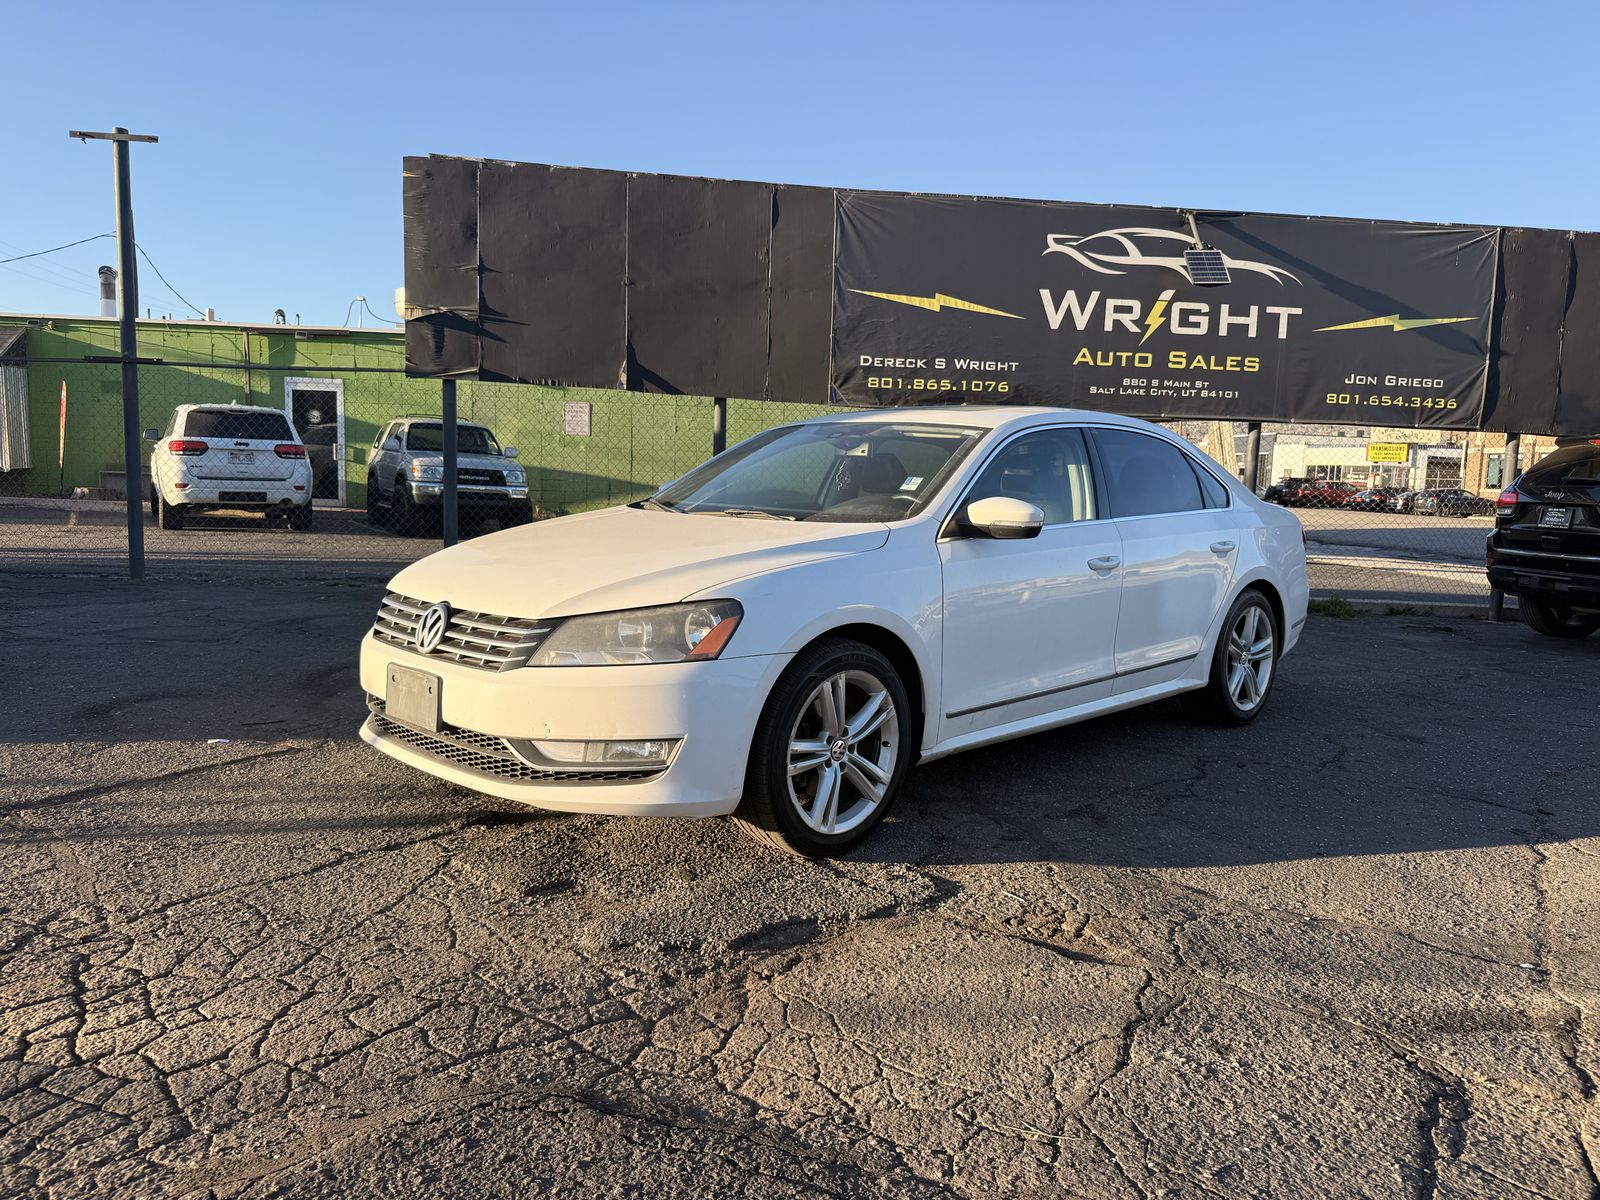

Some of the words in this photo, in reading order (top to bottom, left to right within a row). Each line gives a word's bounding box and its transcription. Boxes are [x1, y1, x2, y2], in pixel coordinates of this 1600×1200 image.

[860, 355, 927, 369] DERECK
[934, 358, 946, 369] S
[954, 358, 1019, 372] WRIGHT
[1073, 347, 1153, 368] AUTO
[1167, 351, 1260, 372] SALES
[867, 377, 1009, 392] 801.865.1076
[1122, 378, 1147, 386] 880
[1151, 379, 1159, 387] S
[1163, 379, 1191, 388] MAIN
[1195, 380, 1210, 388] ST
[1344, 374, 1377, 386] JON
[1385, 375, 1444, 388] GRIEGO
[1089, 386, 1116, 395] SALT
[1119, 387, 1146, 396] LAKE
[1150, 388, 1177, 398] CITY,
[1181, 389, 1197, 398] UT
[1200, 390, 1239, 399] 84101
[1326, 393, 1457, 409] 801.654.3436
